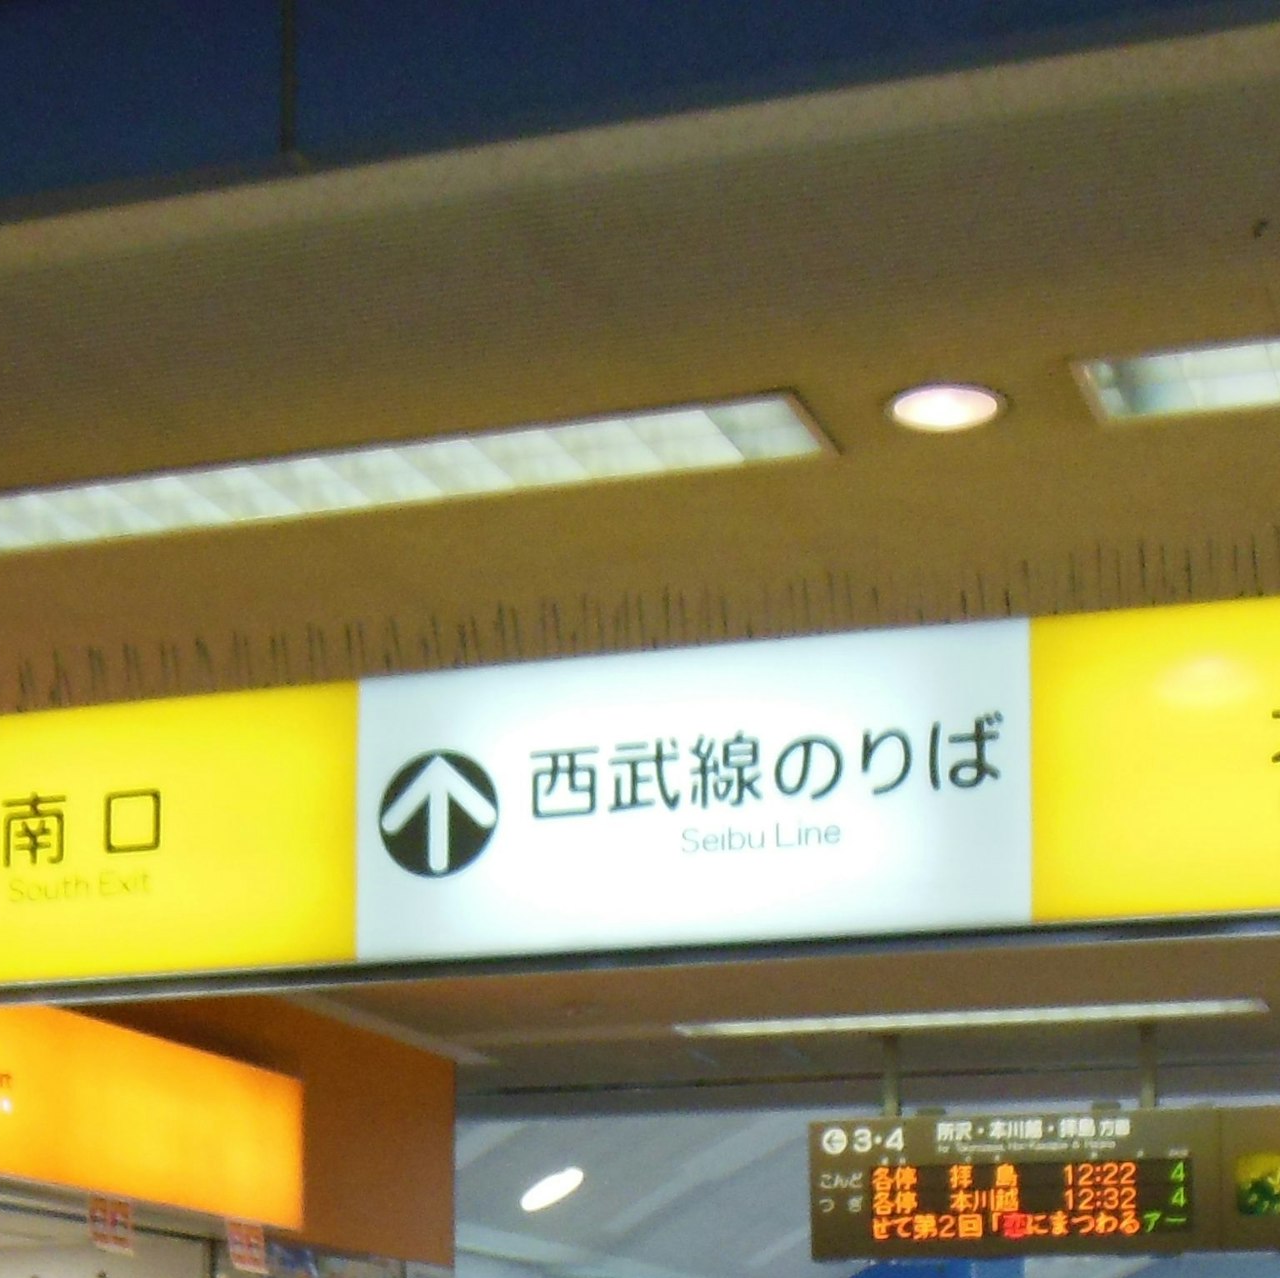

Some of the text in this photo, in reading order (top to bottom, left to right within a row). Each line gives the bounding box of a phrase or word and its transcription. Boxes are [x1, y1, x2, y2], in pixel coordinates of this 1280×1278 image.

[528, 711, 1003, 821] 西武線のりば
[1, 787, 161, 869] 南口
[681, 818, 842, 854] Seibu Line
[7, 868, 152, 904] South Exit
[820, 1172, 863, 1188] こんど
[873, 1166, 917, 1191] 各停
[1064, 1162, 1136, 1185] 12:22
[1171, 1161, 1185, 1182] 4
[873, 1186, 1186, 1215] 各停 本川越 12:32 4
